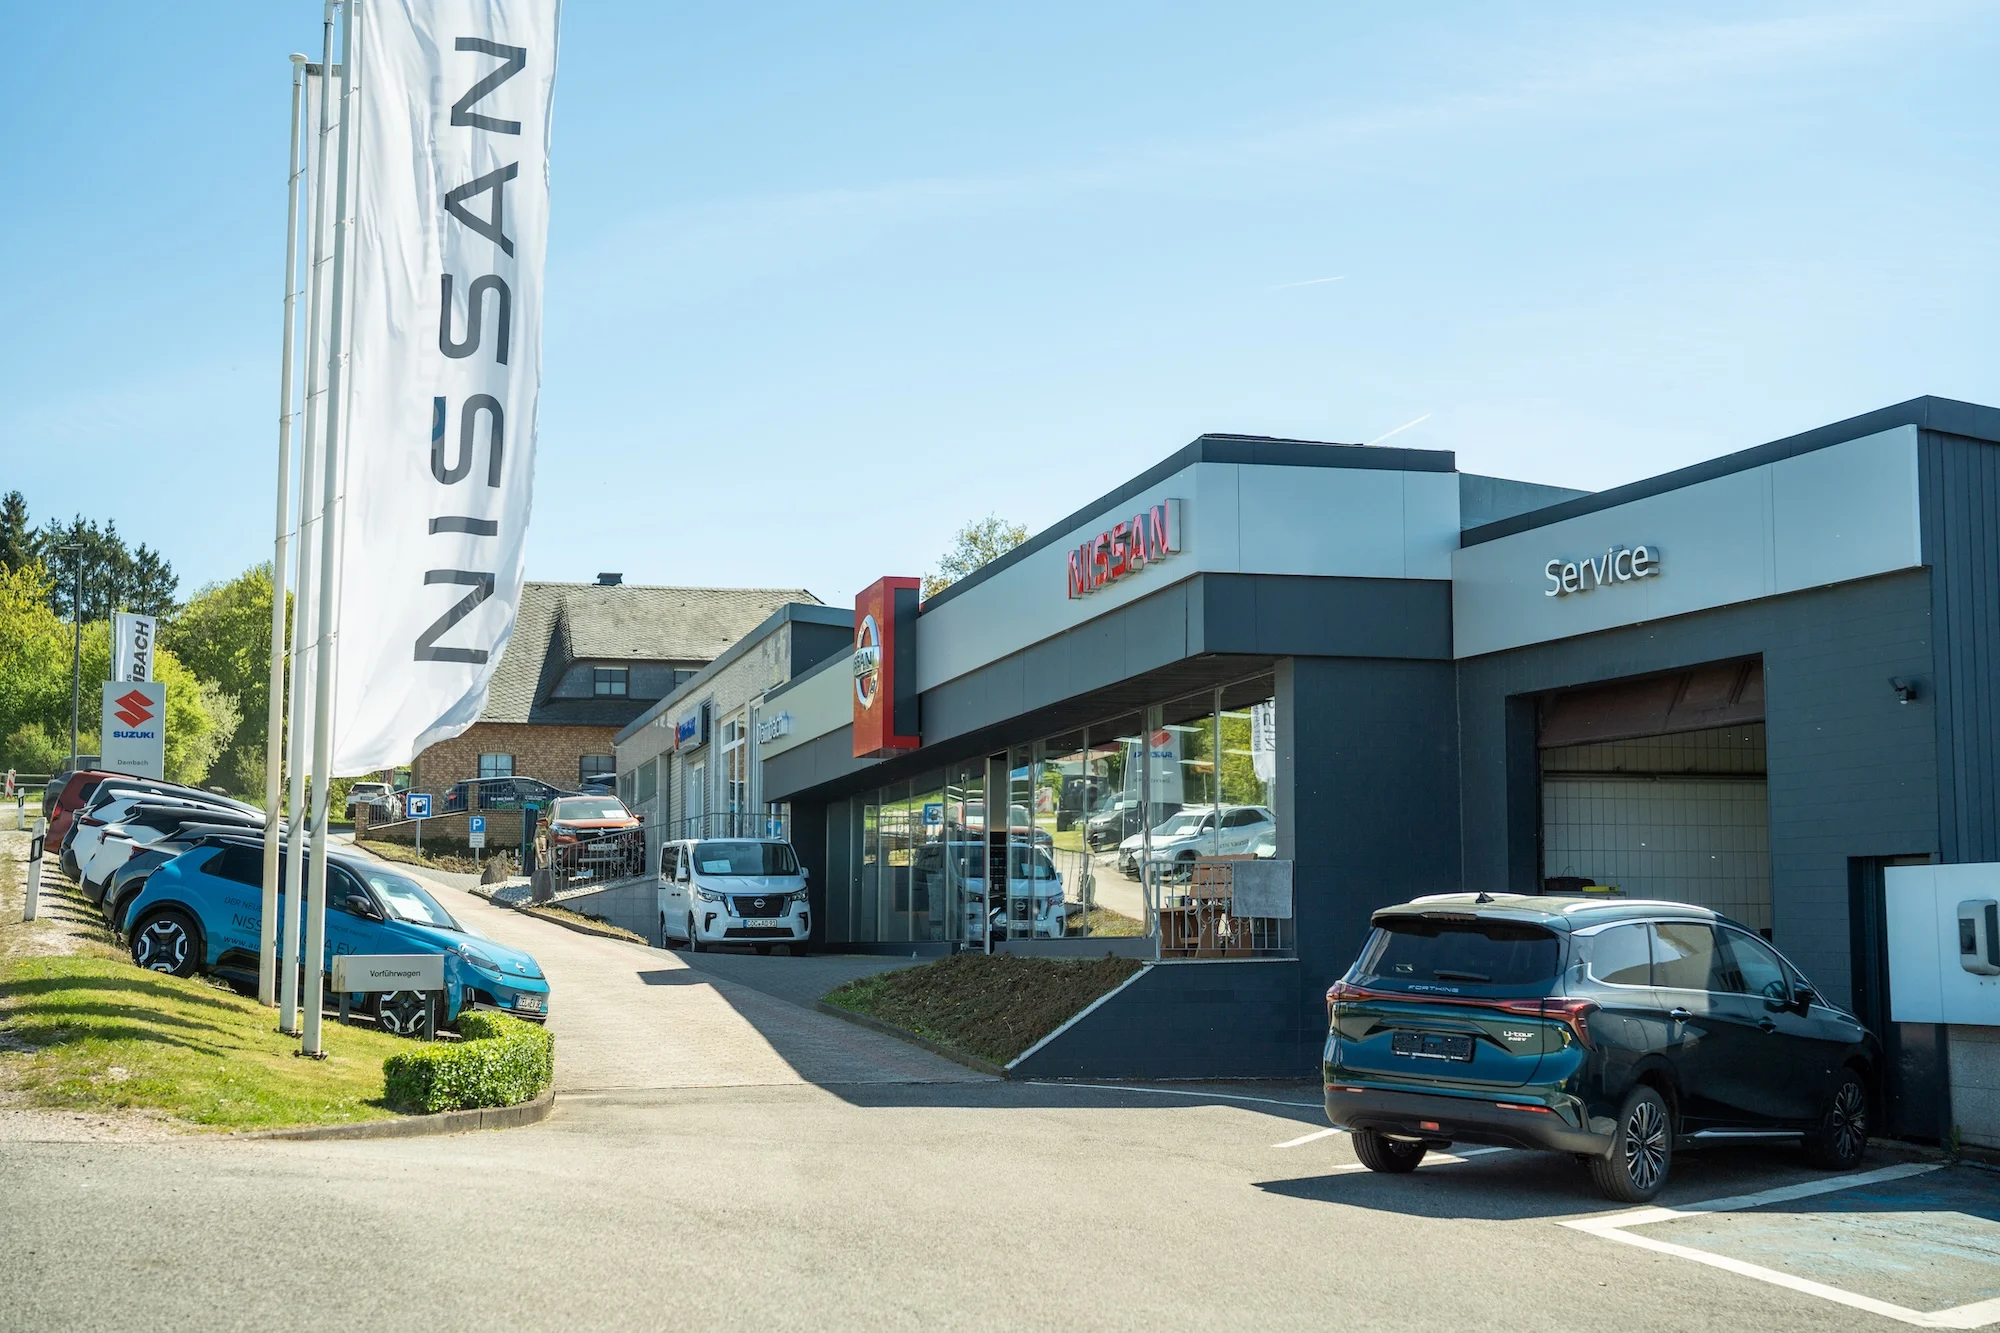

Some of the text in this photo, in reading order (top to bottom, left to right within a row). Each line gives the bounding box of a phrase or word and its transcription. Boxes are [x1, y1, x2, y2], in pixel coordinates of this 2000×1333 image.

[414, 37, 526, 663] NISSAN
[1068, 498, 1178, 600] NISSAN
[1545, 545, 1653, 597] Service
[113, 730, 154, 739] SUZUKI
[473, 818, 482, 831] P
[370, 970, 421, 978] Vorführwagen
[1408, 985, 1459, 993] FORTHING
